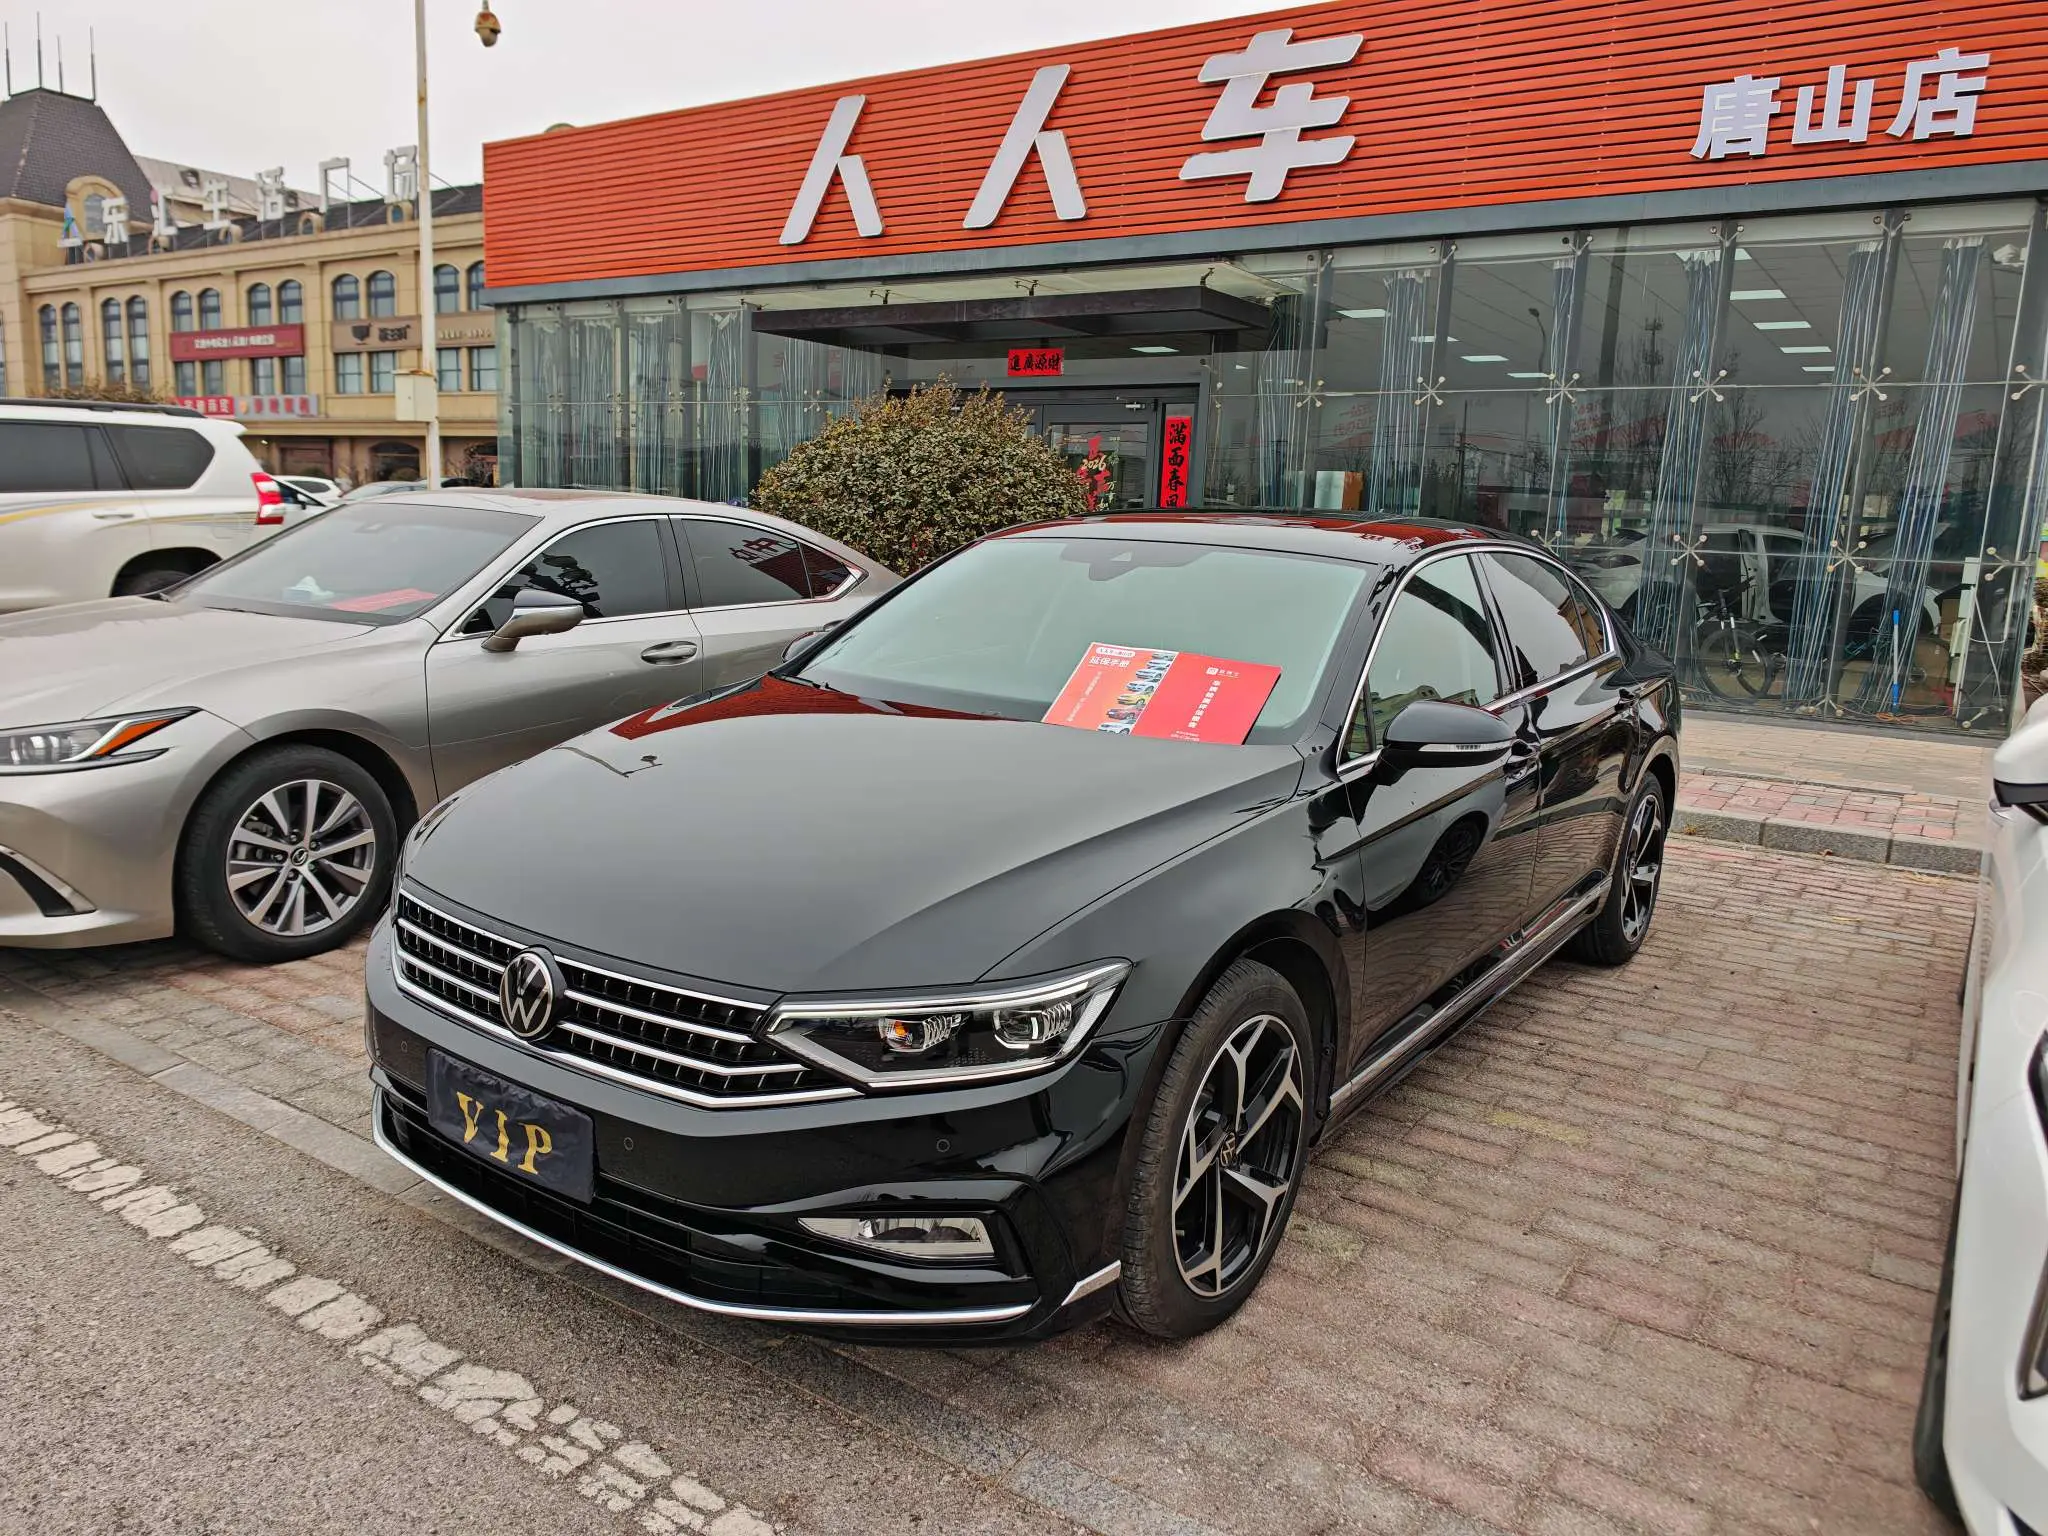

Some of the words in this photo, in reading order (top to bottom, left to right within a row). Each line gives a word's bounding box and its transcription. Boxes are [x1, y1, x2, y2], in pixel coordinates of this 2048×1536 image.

[779, 28, 1364, 246] 人人车
[1690, 47, 1991, 160] 唐山店
[1082, 455, 1106, 471] 2026
[456, 1092, 552, 1175] VIP
